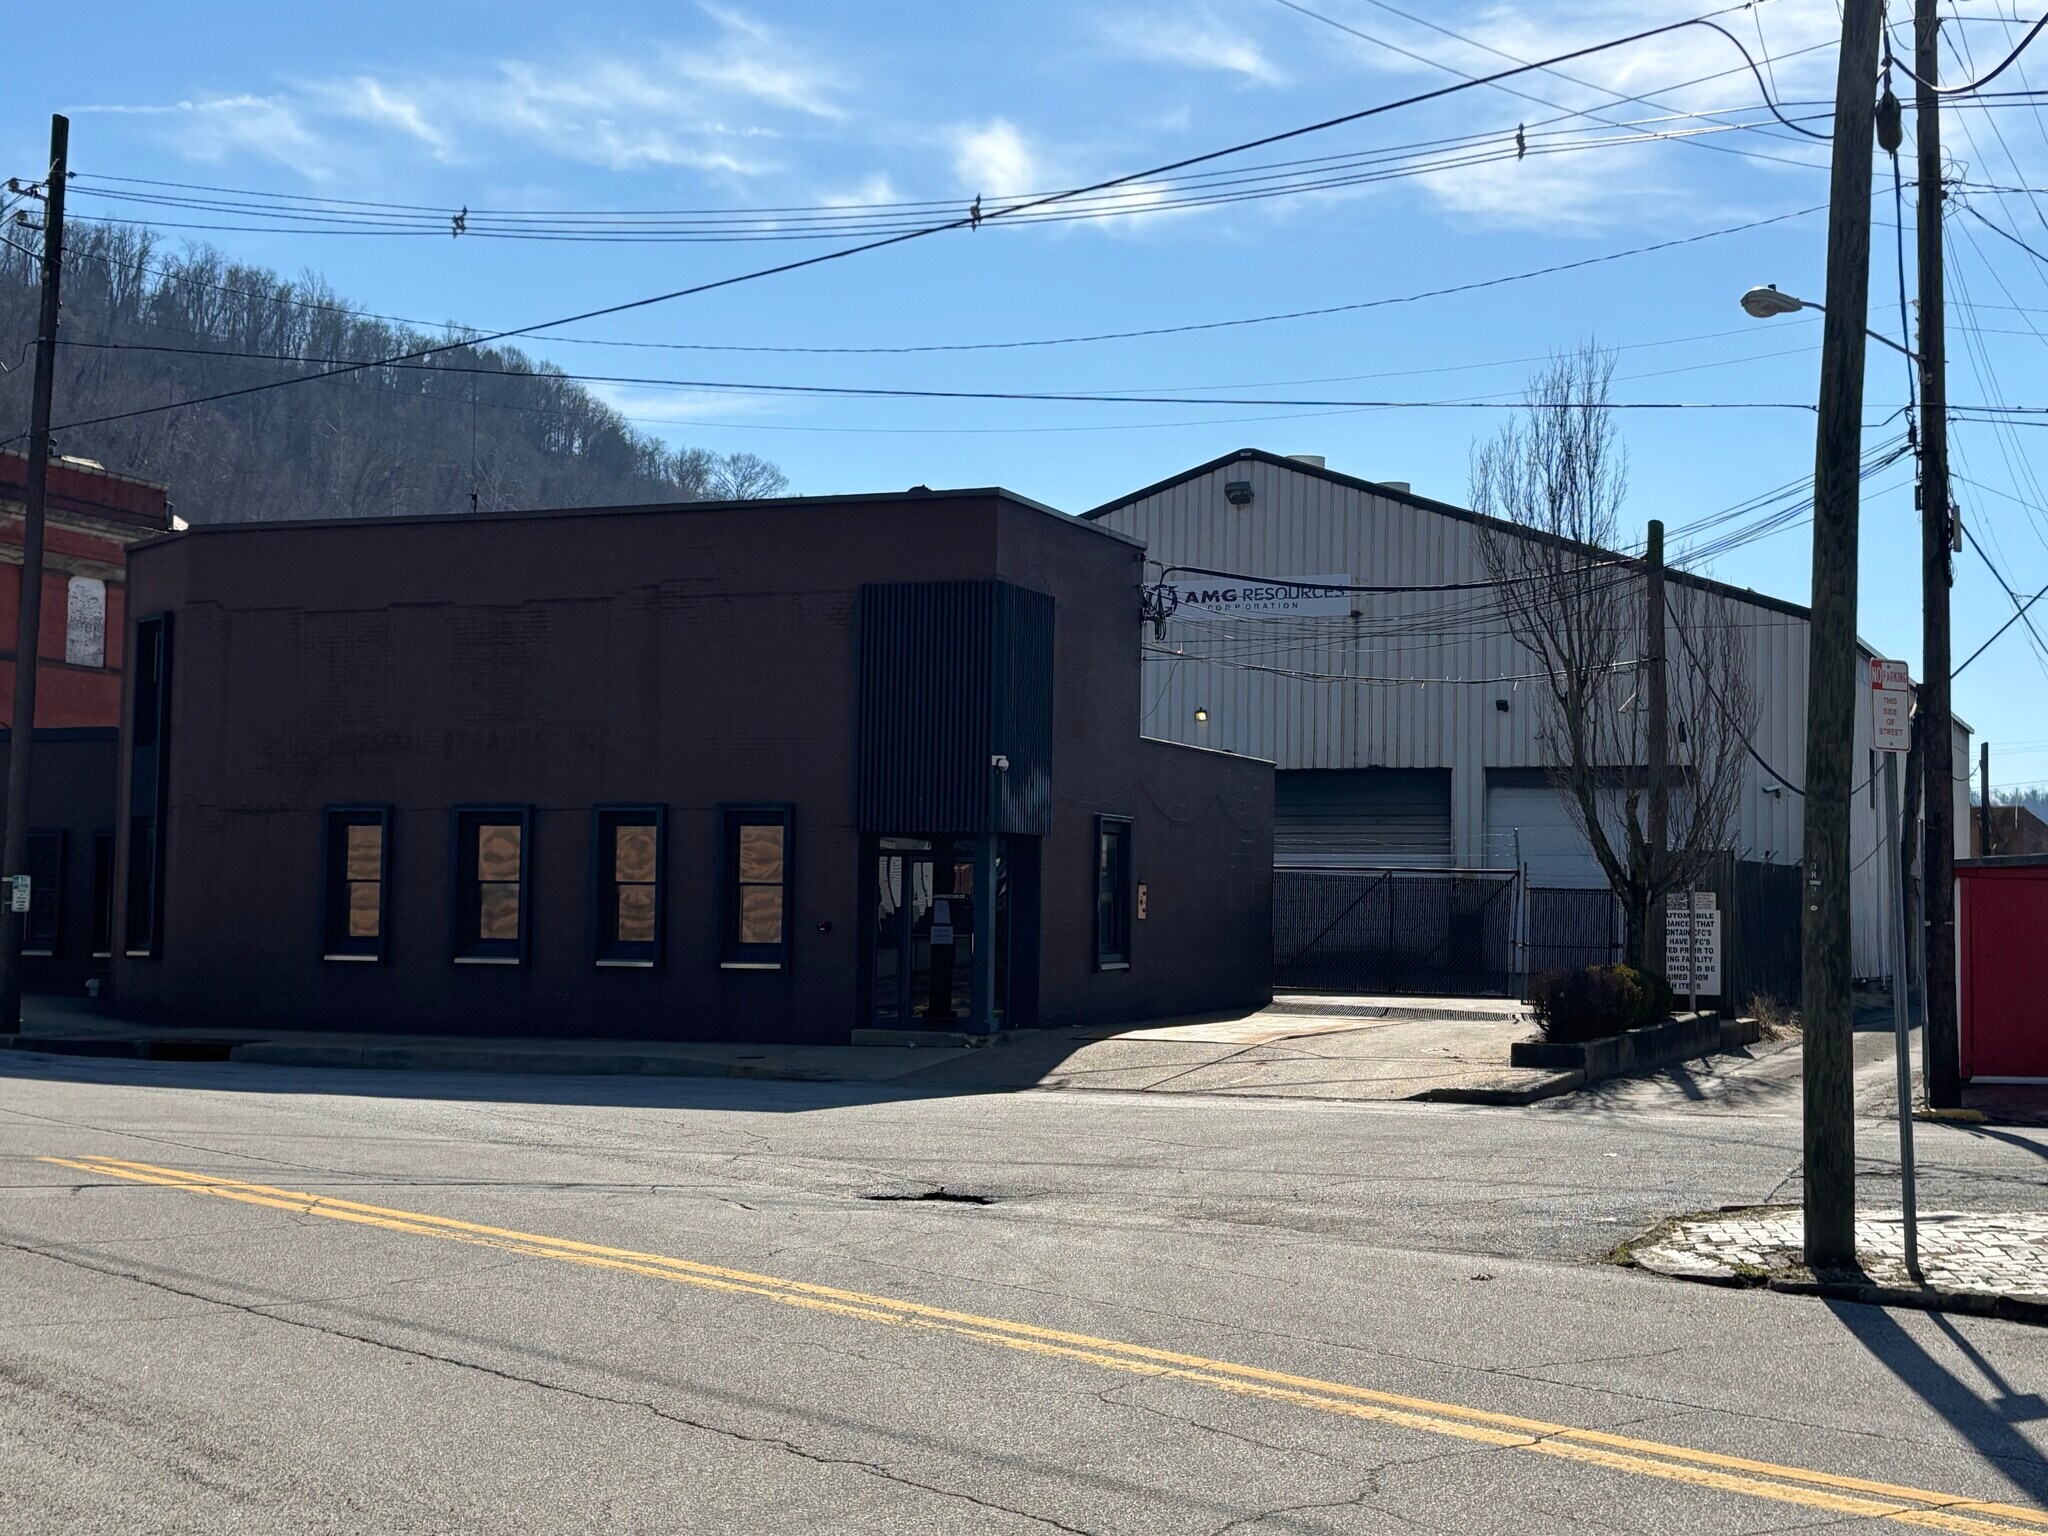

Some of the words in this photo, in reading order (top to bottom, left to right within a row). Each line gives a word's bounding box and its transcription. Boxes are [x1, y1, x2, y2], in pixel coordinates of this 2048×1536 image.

[1184, 588, 1237, 603] AMG
[1242, 586, 1345, 602] RESOURCES
[1207, 602, 1299, 612] CORPORATION
[1872, 666, 1882, 684] NO
[1883, 670, 1906, 684] PARKING
[1883, 697, 1897, 705] THIS
[1883, 708, 1897, 716] SIDE
[1886, 718, 1895, 726] OF
[1879, 728, 1903, 737] STREET
[1666, 912, 1715, 920] UTOMBILE
[1696, 920, 1715, 928] THAT
[1682, 955, 1713, 963] FAILITY
[1668, 964, 1702, 972] SHOUD
[1705, 965, 1716, 973] BE
[1678, 982, 1701, 990] ITES
